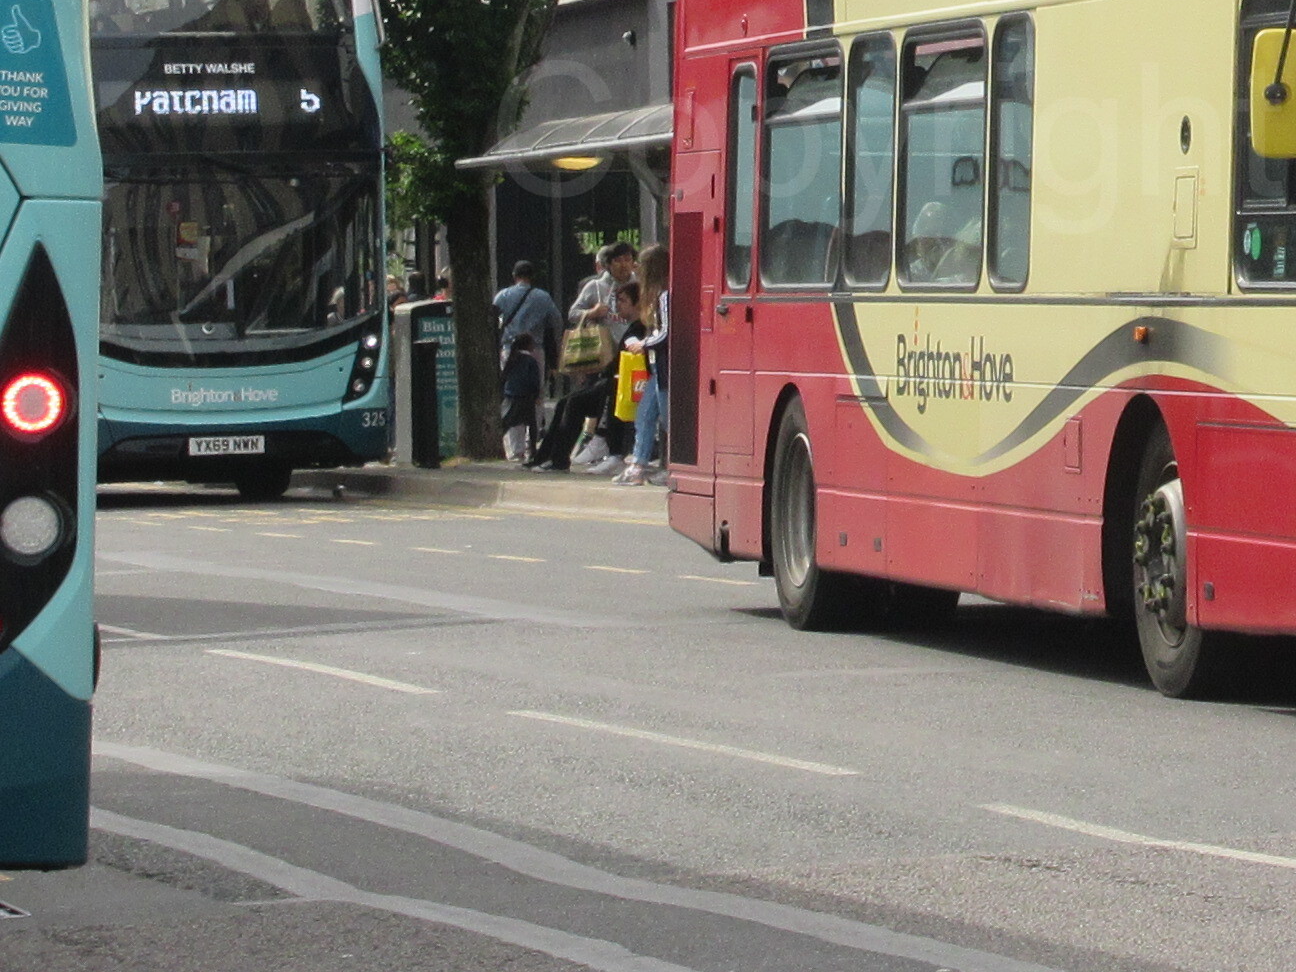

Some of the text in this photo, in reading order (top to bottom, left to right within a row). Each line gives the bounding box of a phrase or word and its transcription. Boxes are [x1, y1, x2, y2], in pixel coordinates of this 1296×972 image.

[163, 62, 256, 75] BETTY WALSHE
[0, 70, 44, 84] THANK
[23, 86, 49, 99] FOR
[0, 99, 42, 114] GIVING
[4, 114, 35, 128] WAY
[361, 412, 387, 428] 325
[194, 437, 230, 452] YX69
